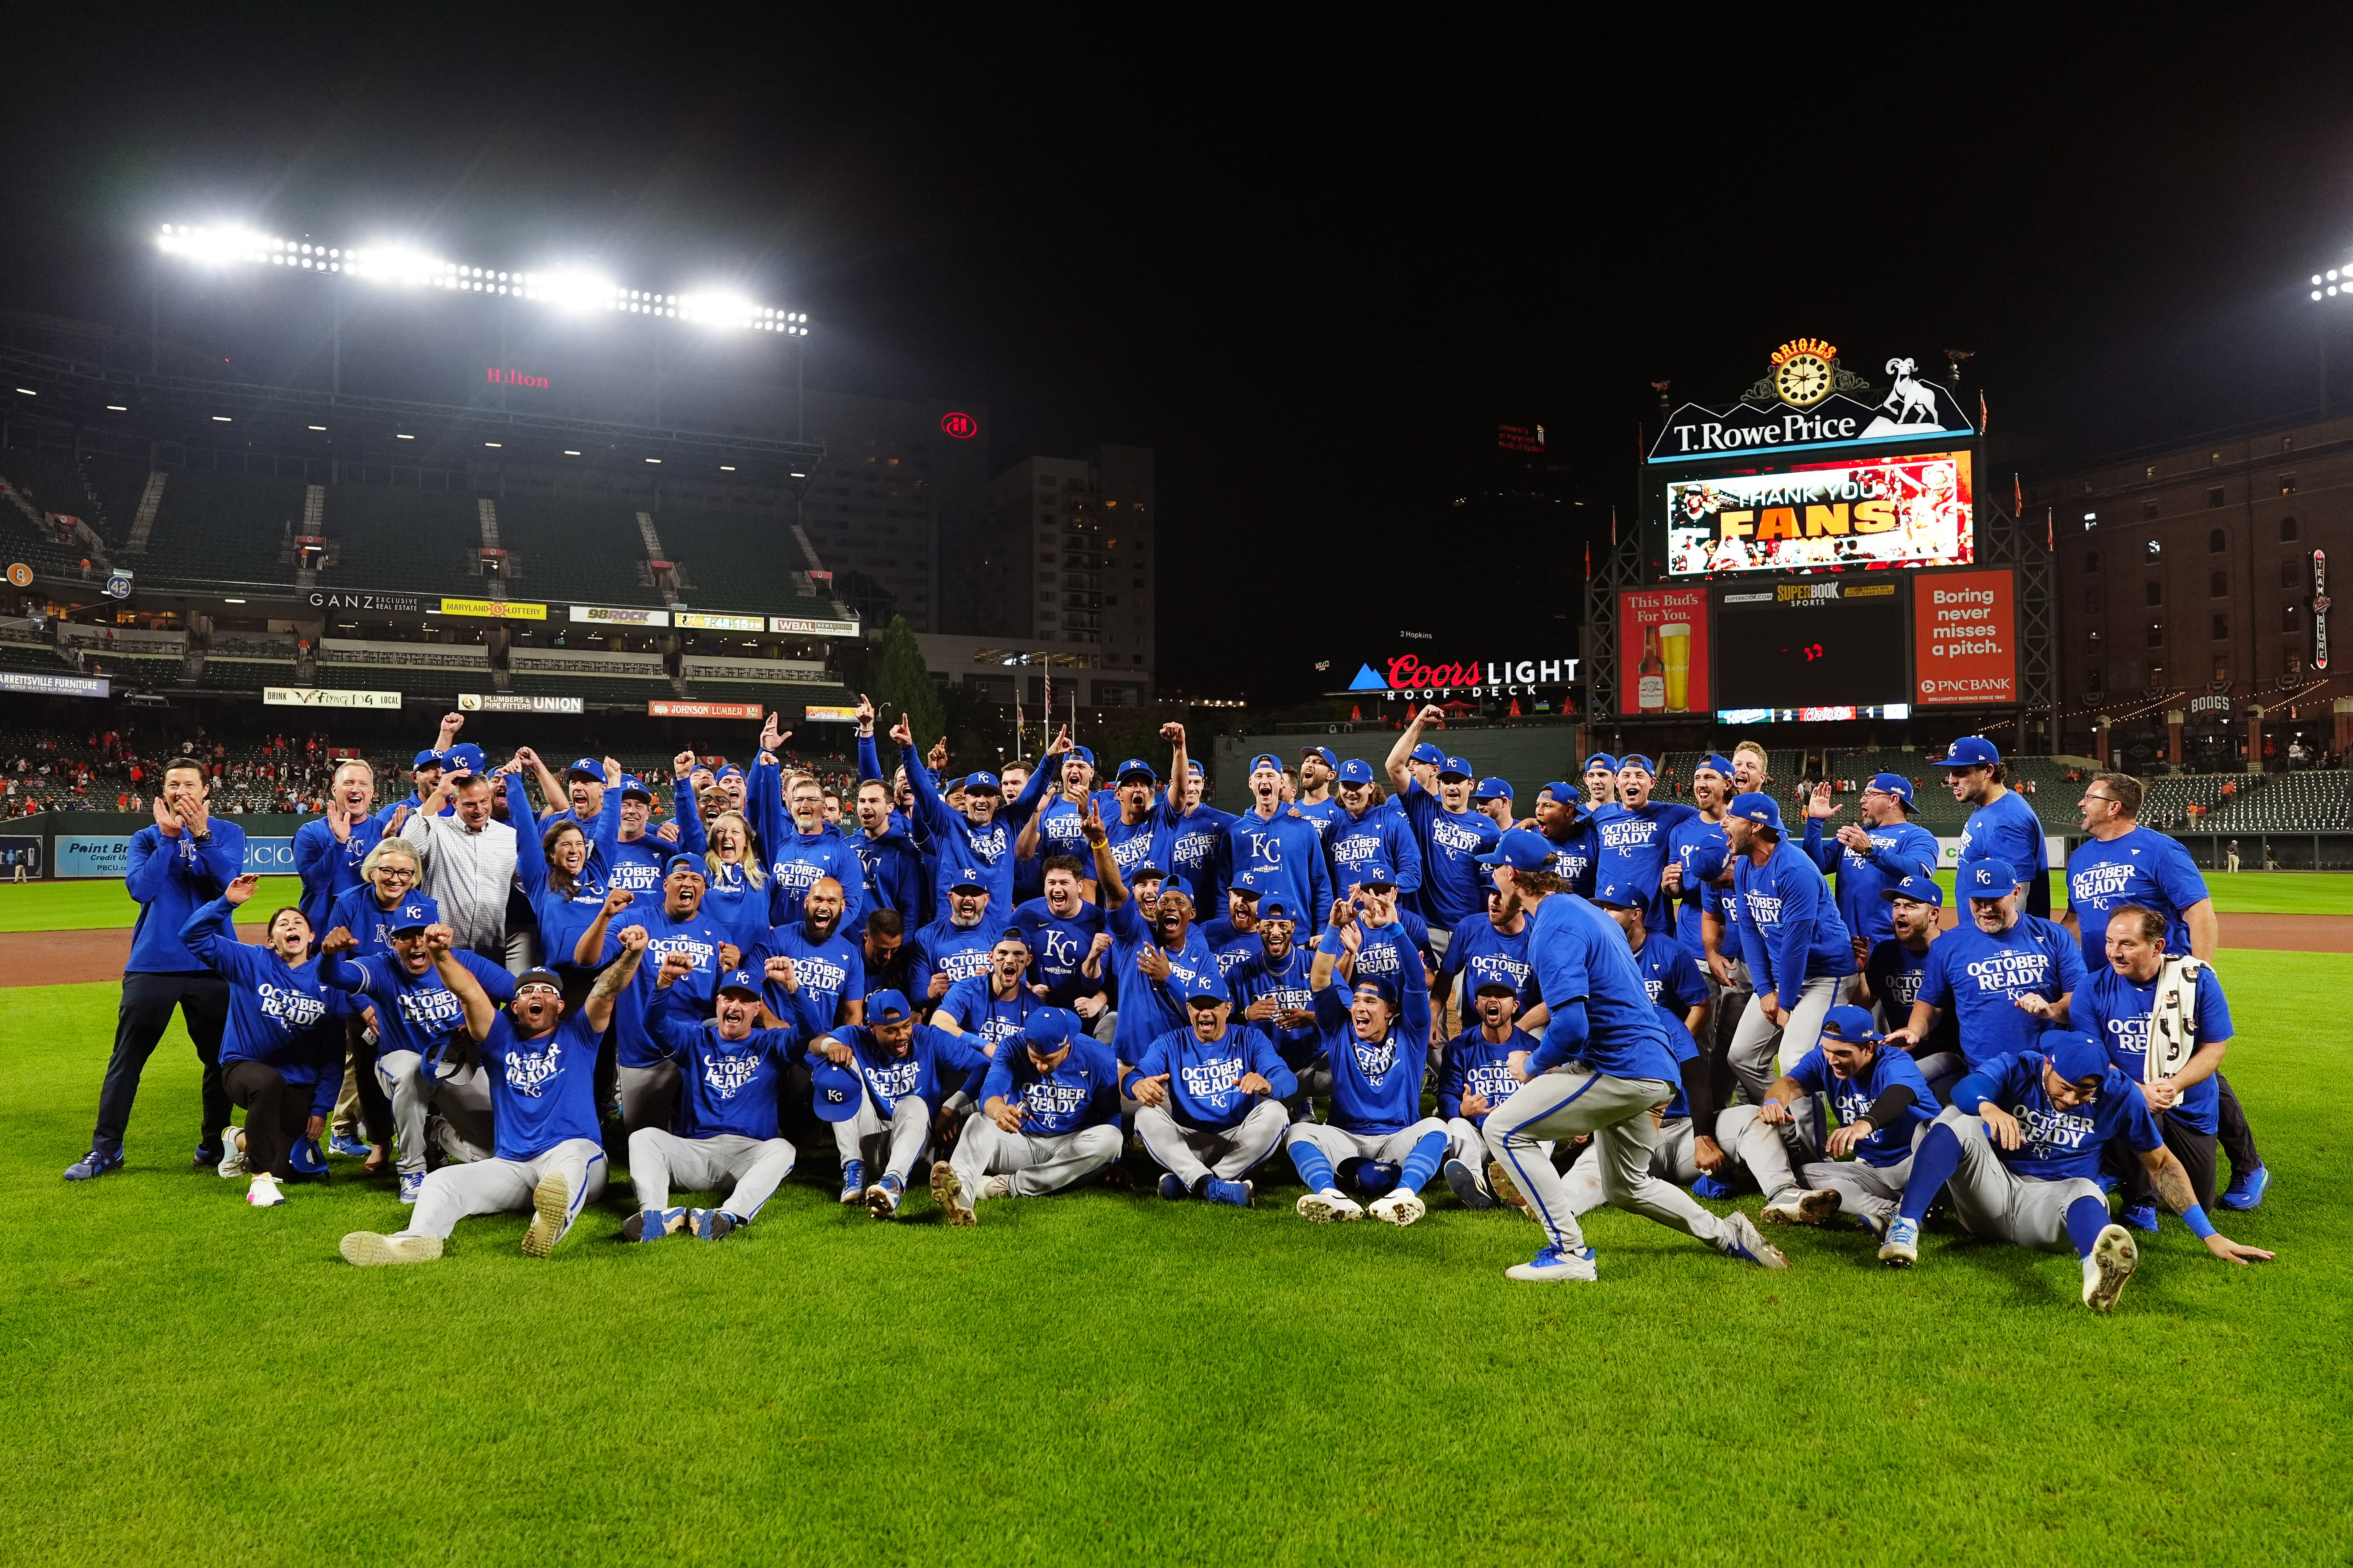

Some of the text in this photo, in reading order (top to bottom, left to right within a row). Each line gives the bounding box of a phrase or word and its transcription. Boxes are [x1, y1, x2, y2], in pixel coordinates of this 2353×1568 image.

[1771, 338, 1836, 364] ORIOLES
[488, 367, 549, 389] Hilton
[1783, 415, 1856, 442] Price
[1739, 482, 1875, 507] THANK YOU
[1721, 500, 1896, 540] FANS
[16, 568, 24, 581] 8
[111, 580, 127, 595] 42
[1777, 581, 1839, 602] SUPERBOOK
[309, 593, 417, 609] GANZ EXCLUSIVE
[1628, 593, 1698, 608] This Bud's
[1791, 599, 1825, 607] SPORTS
[1934, 588, 1994, 604] Boring
[446, 603, 540, 615] MARYLAND LOTTERY
[1637, 609, 1690, 622] For You.
[1938, 608, 1990, 621] never
[749, 622, 762, 630] PM
[779, 621, 815, 631] WBAL
[1933, 623, 1996, 638] misses
[1932, 639, 2002, 658] a pitch.
[1387, 654, 1579, 689] Coors LIGHT
[0, 675, 97, 690] ARRETTSVILLE FURNITURE
[1937, 678, 2010, 691] PNC BANK
[268, 692, 287, 700] DRINK
[353, 694, 374, 706] DOG
[381, 696, 398, 704] LOCAL
[1387, 684, 1536, 700] ROOF DECK
[534, 697, 580, 710] UNION
[671, 704, 708, 715] JOHNSON
[712, 706, 742, 715] LUMBER
[809, 708, 838, 719] Surfside
[1783, 709, 1792, 721] 2
[1804, 706, 1852, 722] Orioles
[1866, 706, 1874, 718] 1
[1433, 818, 1481, 844] OCTOBER
[1602, 822, 1657, 835] OCTOBER
[346, 836, 365, 856] KC
[1331, 837, 1381, 852] OCTOBER
[1434, 830, 1476, 852] READY
[1604, 832, 1652, 847] READY
[69, 843, 108, 853] Point
[1174, 843, 1216, 862] READY
[1250, 833, 1281, 863] KC
[1334, 847, 1376, 862] READY
[1446, 846, 1457, 861] KC
[1618, 846, 1631, 858] KC
[773, 862, 825, 879] OCTOBER
[1143, 860, 1155, 868] KC
[1190, 858, 1202, 870] KC
[1349, 861, 1361, 872] KC
[1853, 857, 1866, 869] KC
[777, 873, 815, 889] READY
[964, 868, 976, 880] KC
[1242, 873, 1254, 884] KC
[1373, 868, 1384, 880] KC
[1976, 870, 1990, 884] KC
[2073, 864, 2136, 886] OCTOBER
[790, 888, 799, 901] KC
[2075, 877, 2128, 899] READY
[2093, 897, 2109, 911] KC
[407, 906, 421, 919] KC
[648, 939, 714, 956] OCTOBER
[1043, 930, 1078, 966] KC
[791, 958, 846, 981] OCTOBER
[1357, 960, 1399, 974] READY
[1472, 956, 1532, 976] OCTOBER
[1967, 954, 2049, 977] OCTOBER
[736, 971, 749, 984] KC
[1199, 976, 1211, 989] KC
[1490, 971, 1502, 981] KC
[1979, 968, 2045, 991] READY
[258, 984, 326, 1014] OCTOBER
[808, 987, 819, 1002] KC
[261, 997, 321, 1025] READY
[404, 1002, 458, 1022] READY
[426, 1022, 441, 1034] KC
[506, 1059, 558, 1087] READY
[865, 1061, 921, 1081] OCTOBER
[1182, 1059, 1243, 1081] OCTOBER
[524, 1085, 542, 1098] KC
[873, 1074, 917, 1098] READY
[1022, 1082, 1086, 1101] OCTOBER
[1189, 1073, 1240, 1096] READY
[721, 1088, 736, 1099] KC
[828, 1090, 842, 1102] KC
[1211, 1094, 1226, 1108] KC
[1026, 1095, 1080, 1113] READY
[1044, 1113, 1056, 1128] KC
[2013, 1105, 2095, 1134] OCTOBER
[2031, 1144, 2051, 1160] KC
